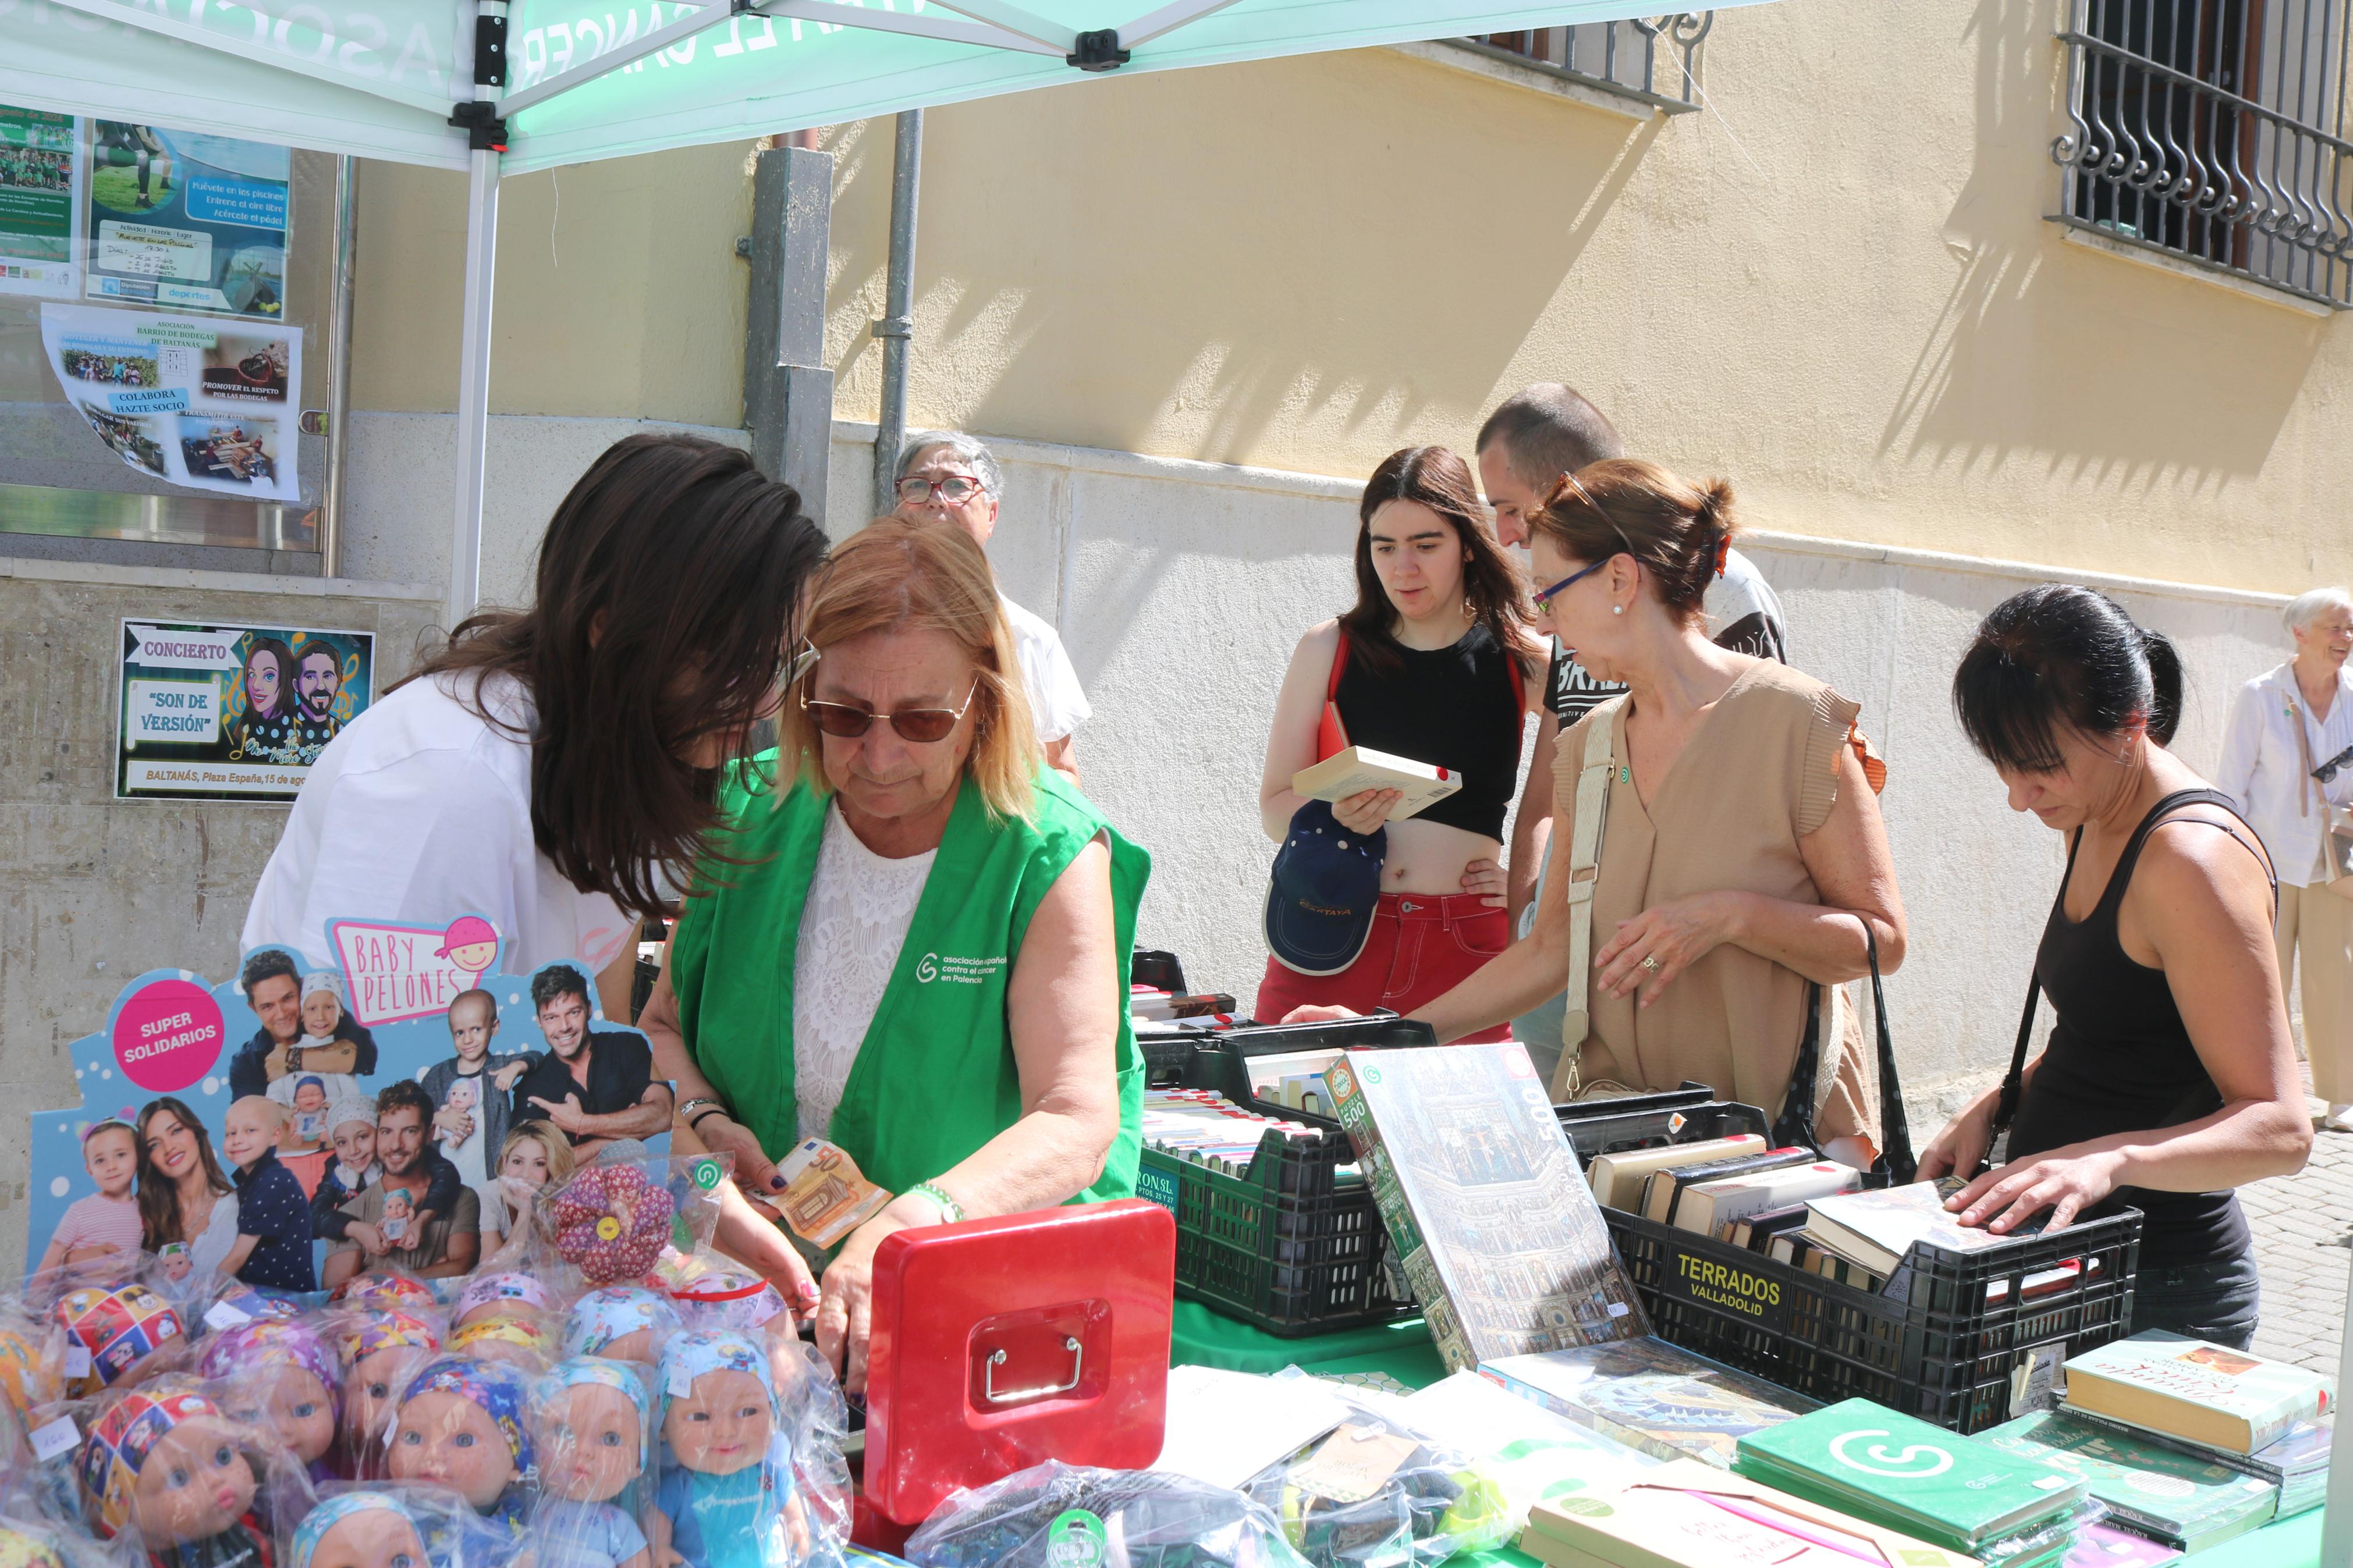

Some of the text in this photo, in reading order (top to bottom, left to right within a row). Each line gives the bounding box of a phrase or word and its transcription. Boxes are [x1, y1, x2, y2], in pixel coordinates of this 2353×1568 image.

[193, 181, 284, 201] Muévete en las piscinas
[206, 195, 283, 214] Entrena al aire libre
[214, 209, 283, 225] Acércate al pádel
[120, 224, 193, 240] Actividad Horario Lugar
[120, 282, 151, 291] Diputación
[169, 289, 210, 301] deportes
[157, 321, 196, 330] ASOCIACIÓN
[137, 327, 215, 341] BARRIO DE BODEGAS
[72, 342, 102, 351] BODEGAS
[118, 346, 149, 355] ENTORNO
[107, 336, 150, 347] MANTENER
[151, 337, 201, 349] DE BALTANÁS
[202, 381, 243, 392] PROMOVER
[251, 386, 279, 395] RESPETO
[119, 389, 176, 402] COLABORA
[239, 394, 268, 402] BODEGAS
[116, 401, 185, 414] HAZTE SOCIO
[184, 409, 229, 419] TRANSMITIR
[126, 418, 154, 429] VALORES
[144, 640, 227, 661] CONCIERTO
[149, 692, 208, 709] “SON DE
[141, 712, 211, 733] VERSIÓN”
[146, 769, 200, 783] BALTANÁS,
[202, 771, 227, 783] Plaza
[277, 774, 289, 784] de
[354, 934, 414, 973] BABY
[943, 956, 984, 966] asociación
[942, 965, 968, 974] contra
[953, 975, 983, 984] Palencia
[363, 968, 462, 1014] PELONES
[140, 1011, 193, 1039] SUPER
[124, 1024, 217, 1064] SOLIDARIOS
[1340, 1093, 1361, 1115] PUZZLE
[1343, 1101, 1365, 1129] 500
[1521, 1087, 1561, 1143] 500
[808, 1144, 843, 1173] 50
[1138, 1187, 1155, 1198] PTOS.
[1155, 1192, 1162, 1200] 25
[1677, 1253, 1781, 1306] TERRADOS
[1690, 1283, 1763, 1317] VALLADOLID
[2056, 1405, 2072, 1416] SERNA
[2079, 1412, 2087, 1420] DE
[2087, 1414, 2107, 1427] PULGAR
[2118, 1507, 2143, 1521] RAQUEL
[2123, 1526, 2148, 1539] RAQUEL
